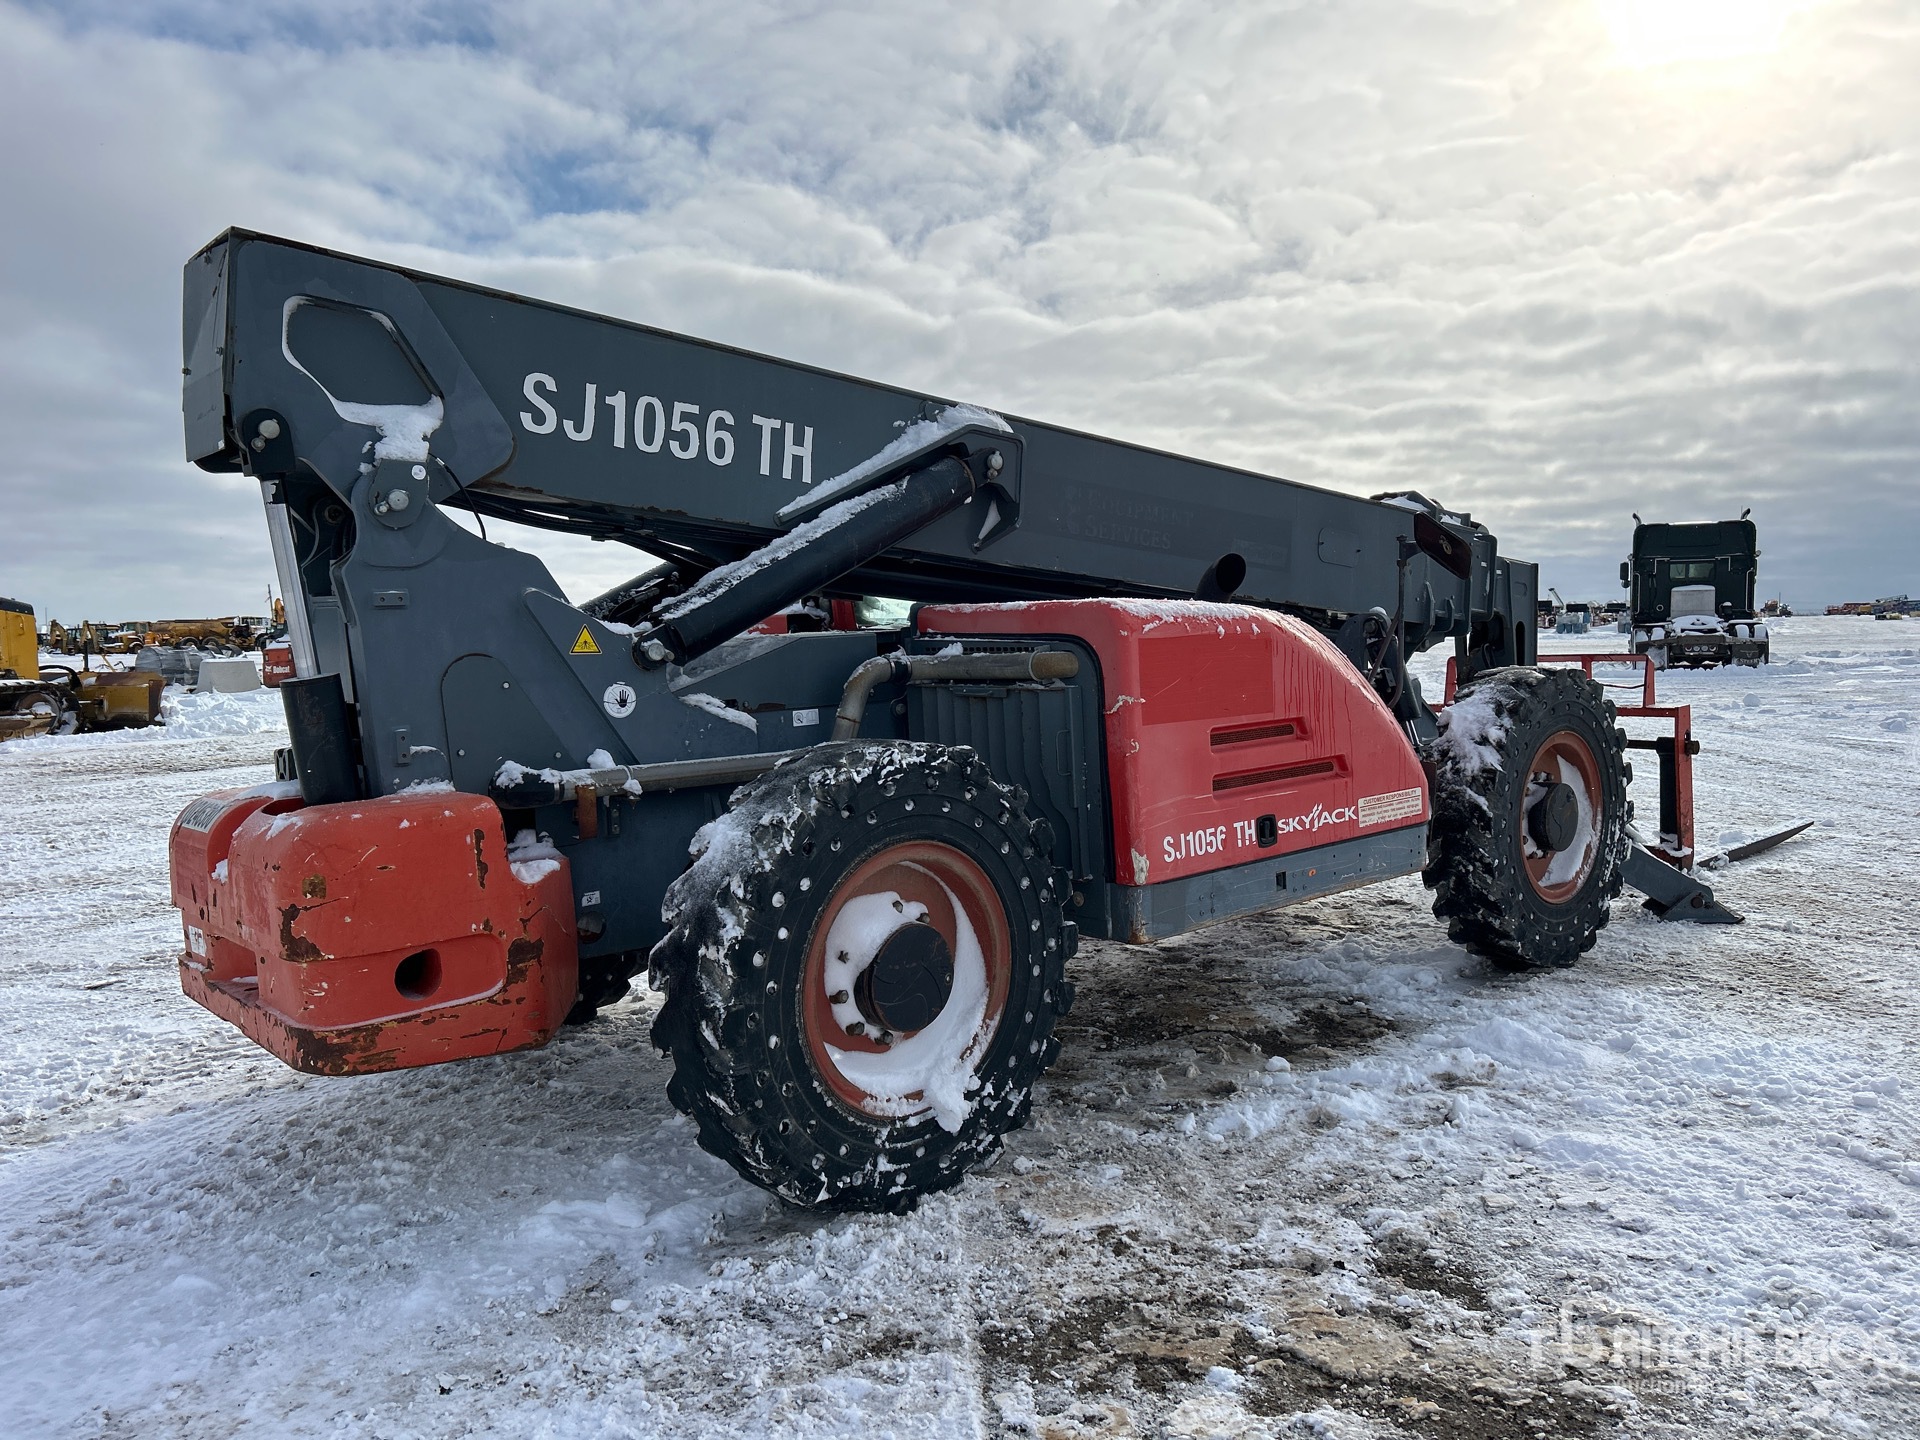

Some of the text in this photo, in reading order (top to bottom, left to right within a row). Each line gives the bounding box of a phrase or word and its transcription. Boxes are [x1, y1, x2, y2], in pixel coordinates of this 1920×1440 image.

[519, 372, 814, 484] SJ1056 TH
[1233, 819, 1257, 848] TH
[1278, 803, 1358, 832] SKYJACK
